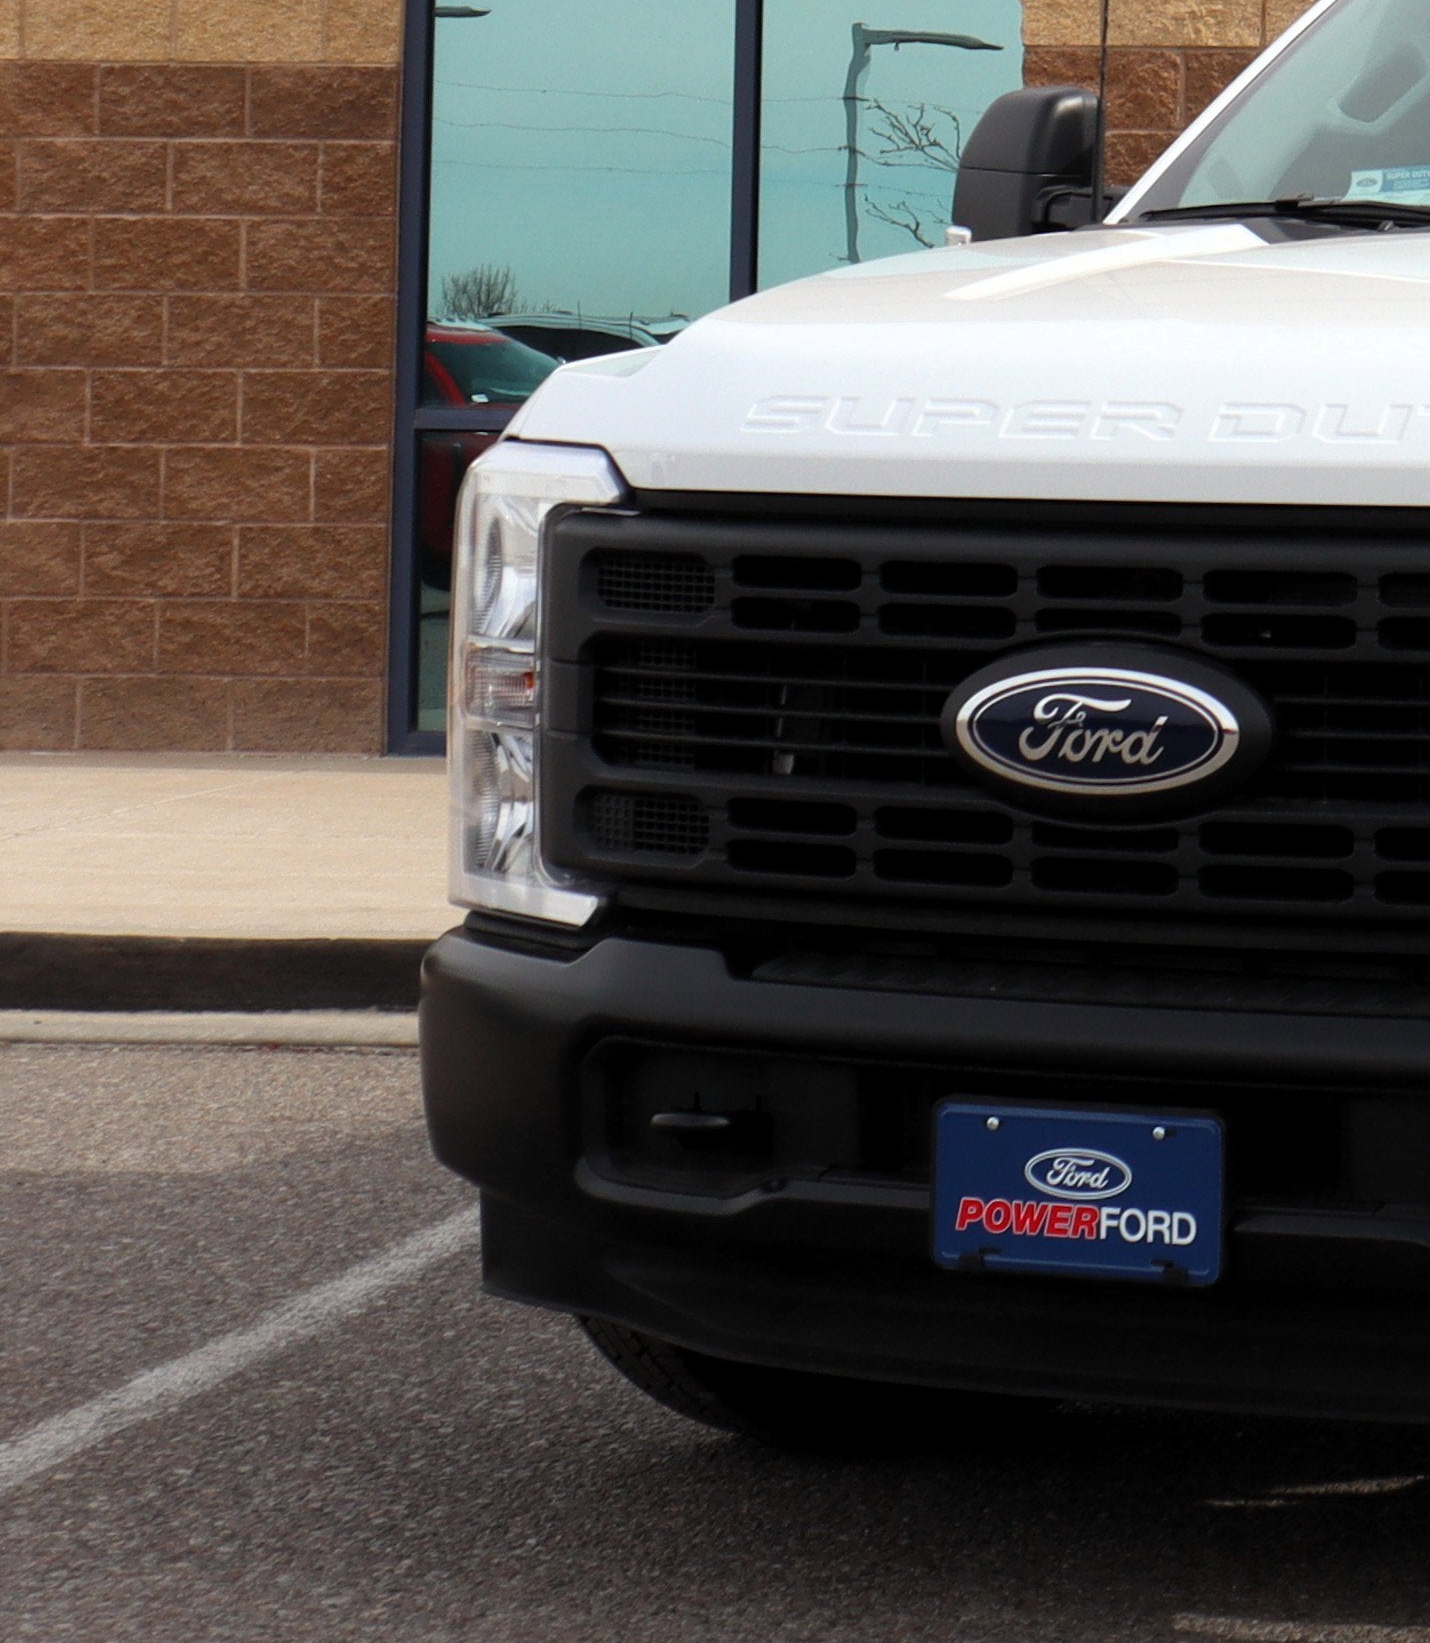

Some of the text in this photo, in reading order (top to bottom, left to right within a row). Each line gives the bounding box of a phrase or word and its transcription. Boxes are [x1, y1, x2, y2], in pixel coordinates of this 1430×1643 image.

[741, 394, 1186, 441] SUPER
[1019, 693, 1168, 765] Ford
[1046, 1155, 1111, 1189] Ford
[956, 1197, 1198, 1245] POWERFORD
